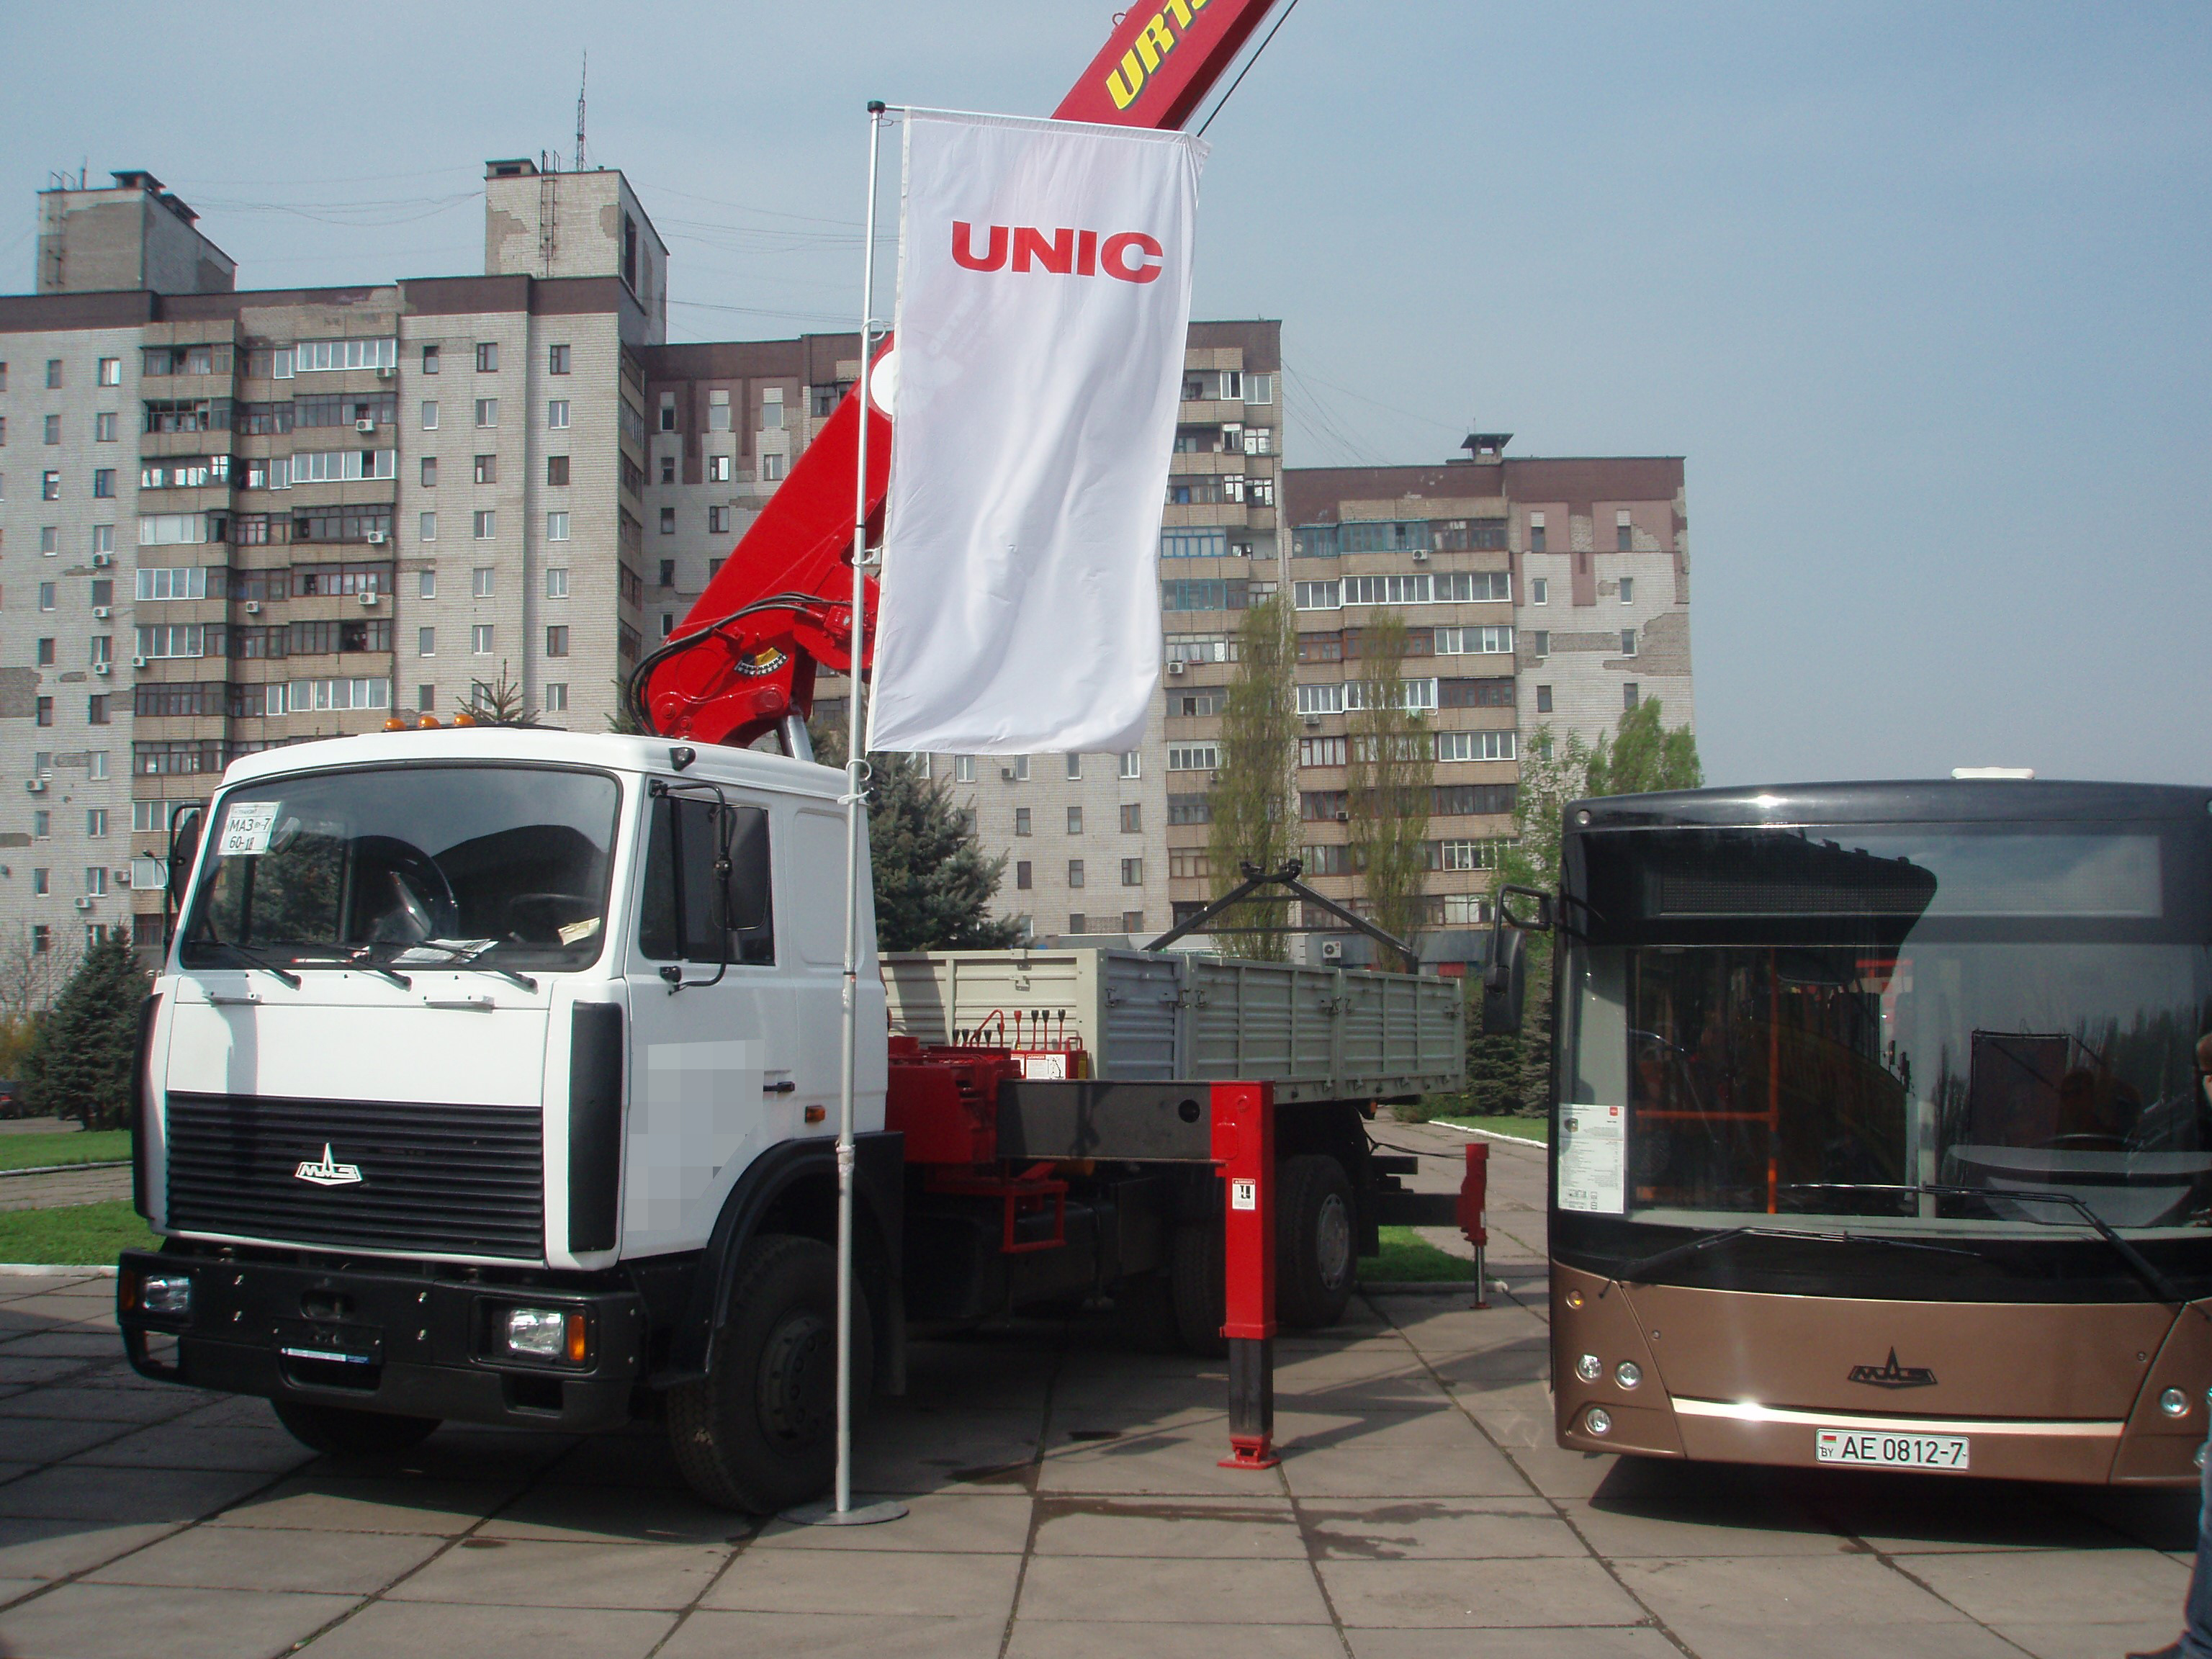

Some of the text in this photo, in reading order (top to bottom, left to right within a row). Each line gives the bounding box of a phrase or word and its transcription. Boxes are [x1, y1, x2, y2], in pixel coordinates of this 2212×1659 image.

[1105, 0, 1208, 110] UR1
[952, 220, 1164, 284] UNIC
[1821, 1447, 1834, 1457] BY
[1841, 1436, 1964, 1465] AE 0812-7
